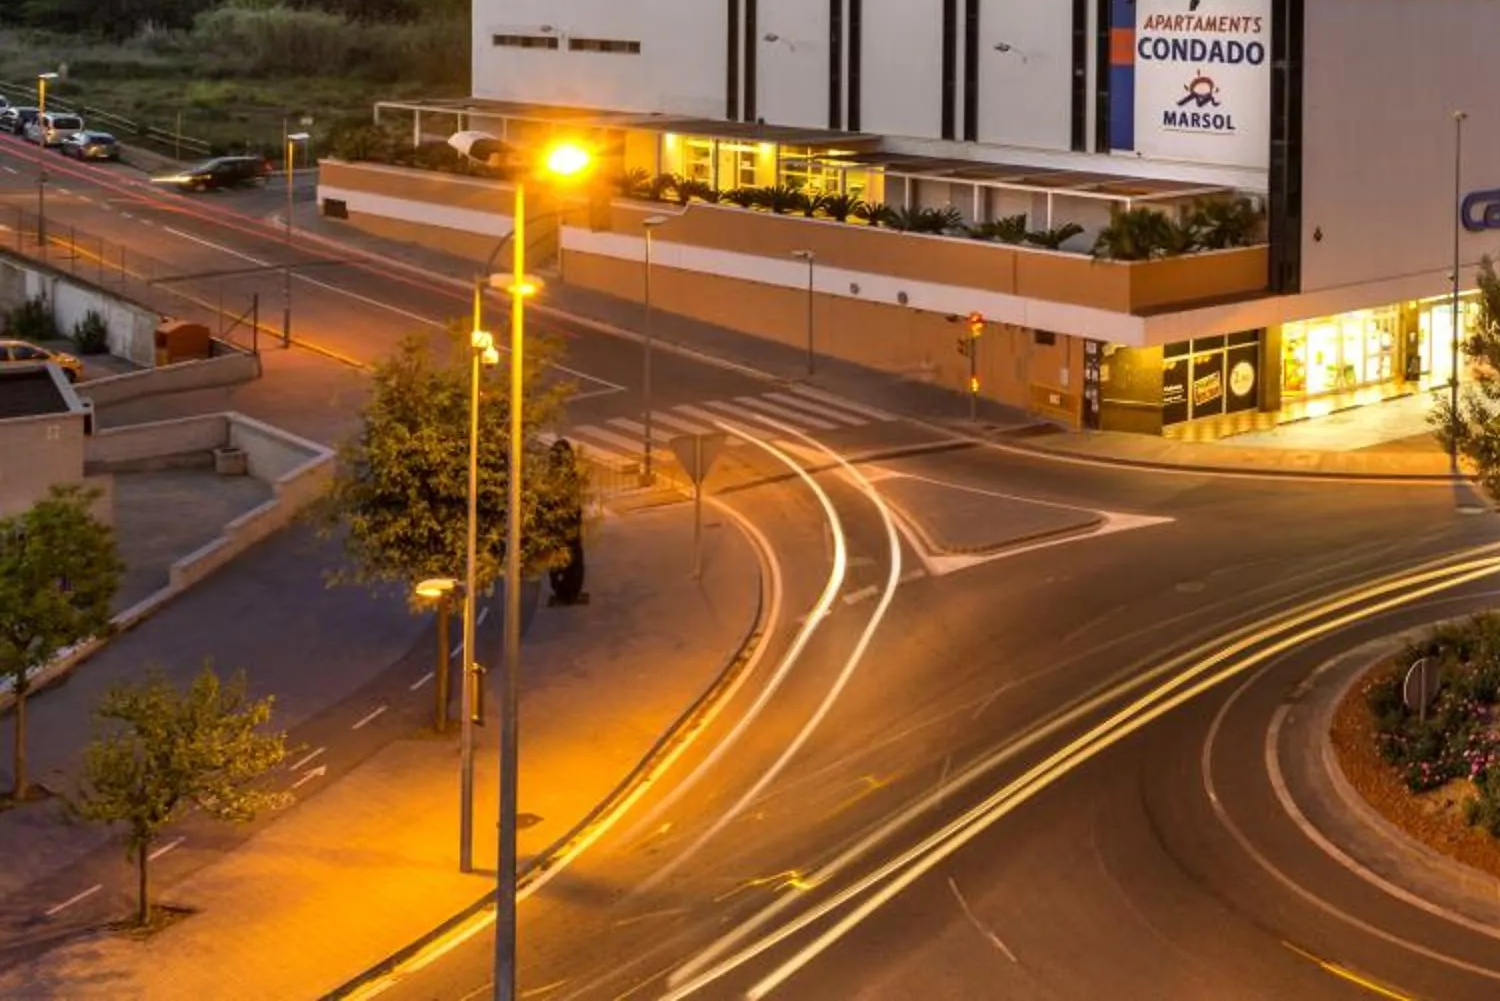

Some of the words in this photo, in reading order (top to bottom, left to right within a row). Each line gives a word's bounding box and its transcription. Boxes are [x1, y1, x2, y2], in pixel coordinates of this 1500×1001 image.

[1143, 14, 1262, 33] APARTAMENTS
[1138, 36, 1265, 65] CONDADO
[1163, 110, 1236, 130] MARSOL
